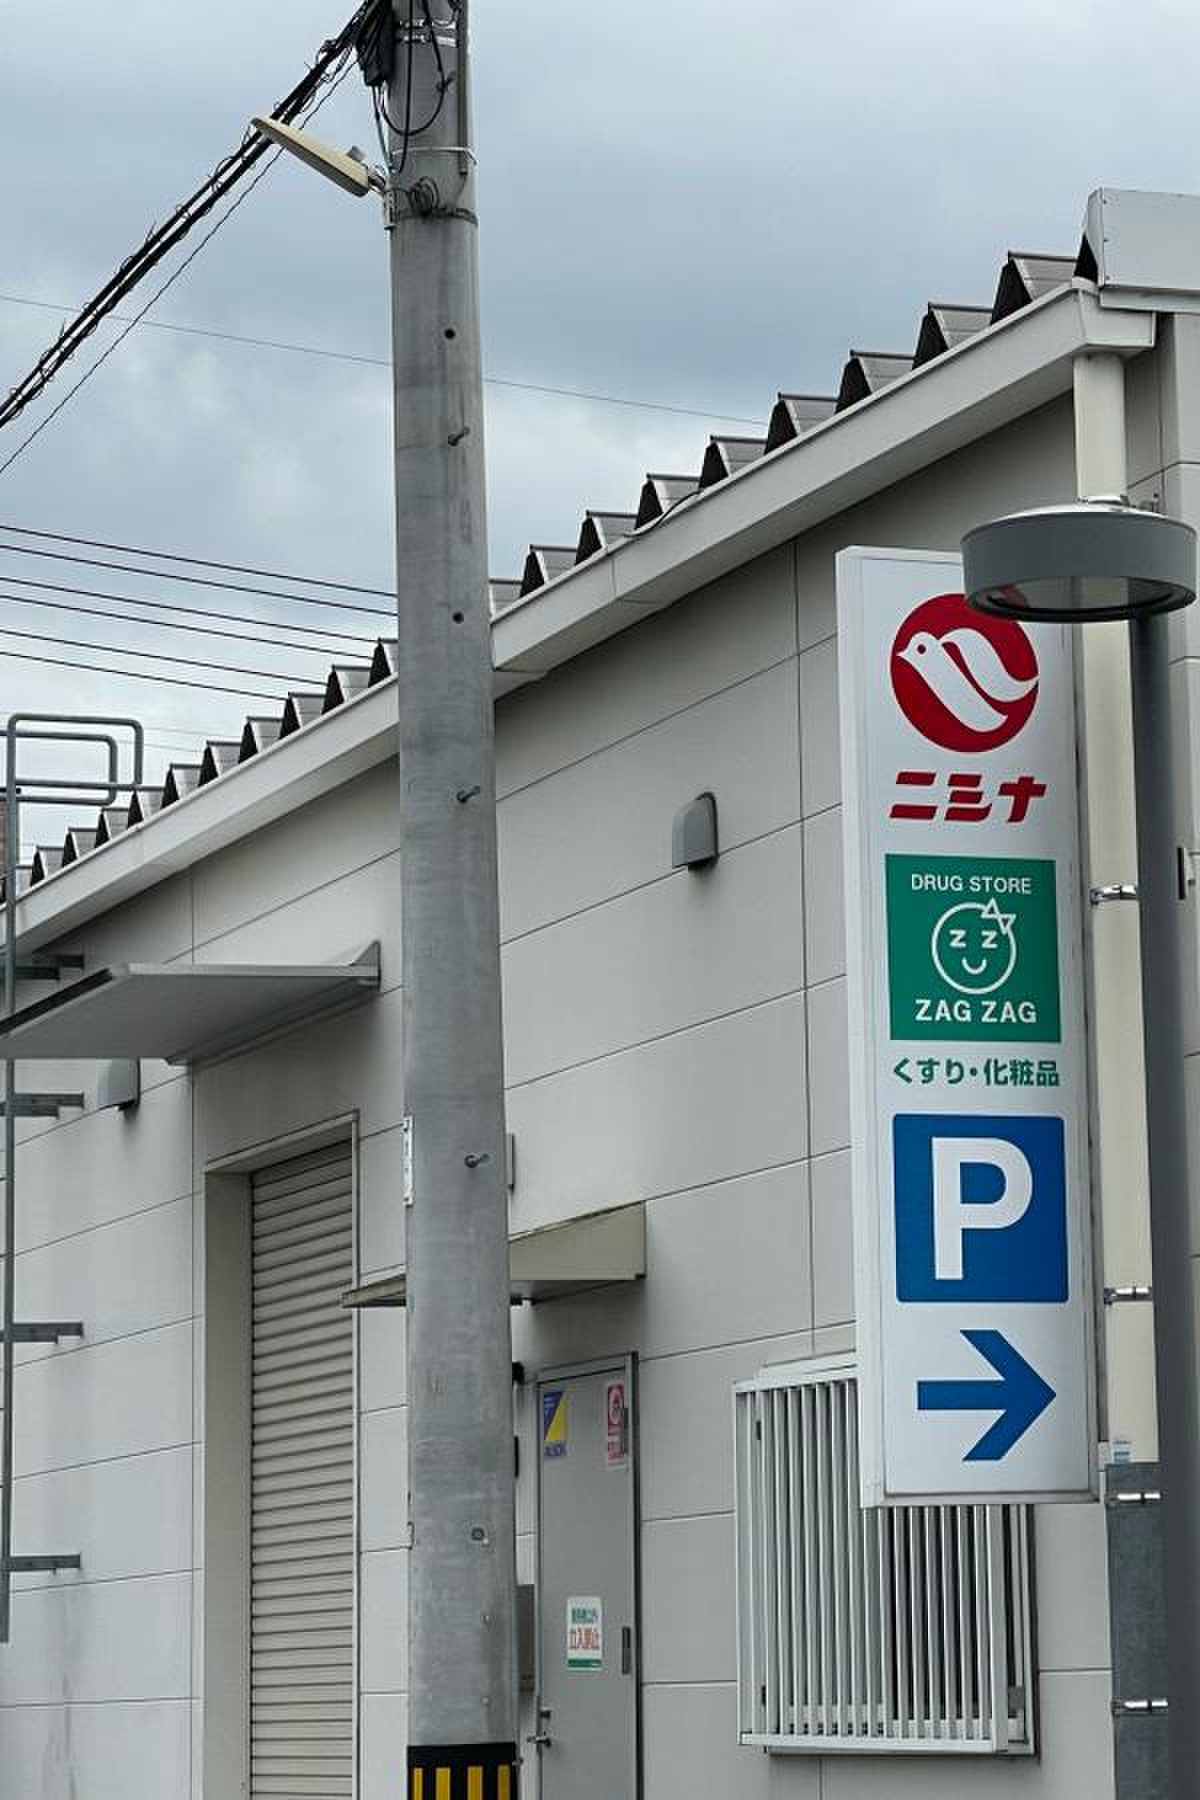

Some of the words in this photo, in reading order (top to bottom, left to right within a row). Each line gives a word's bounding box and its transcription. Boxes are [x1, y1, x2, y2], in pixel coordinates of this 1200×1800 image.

[889, 770, 1046, 823] ニシナ
[910, 873, 964, 893] DRUG
[969, 875, 1033, 896] STORE
[914, 999, 972, 1023] ZAG
[981, 1000, 1037, 1025] ZAG
[892, 1057, 1060, 1088] くすり・化粧品
[931, 1136, 1033, 1281] P
